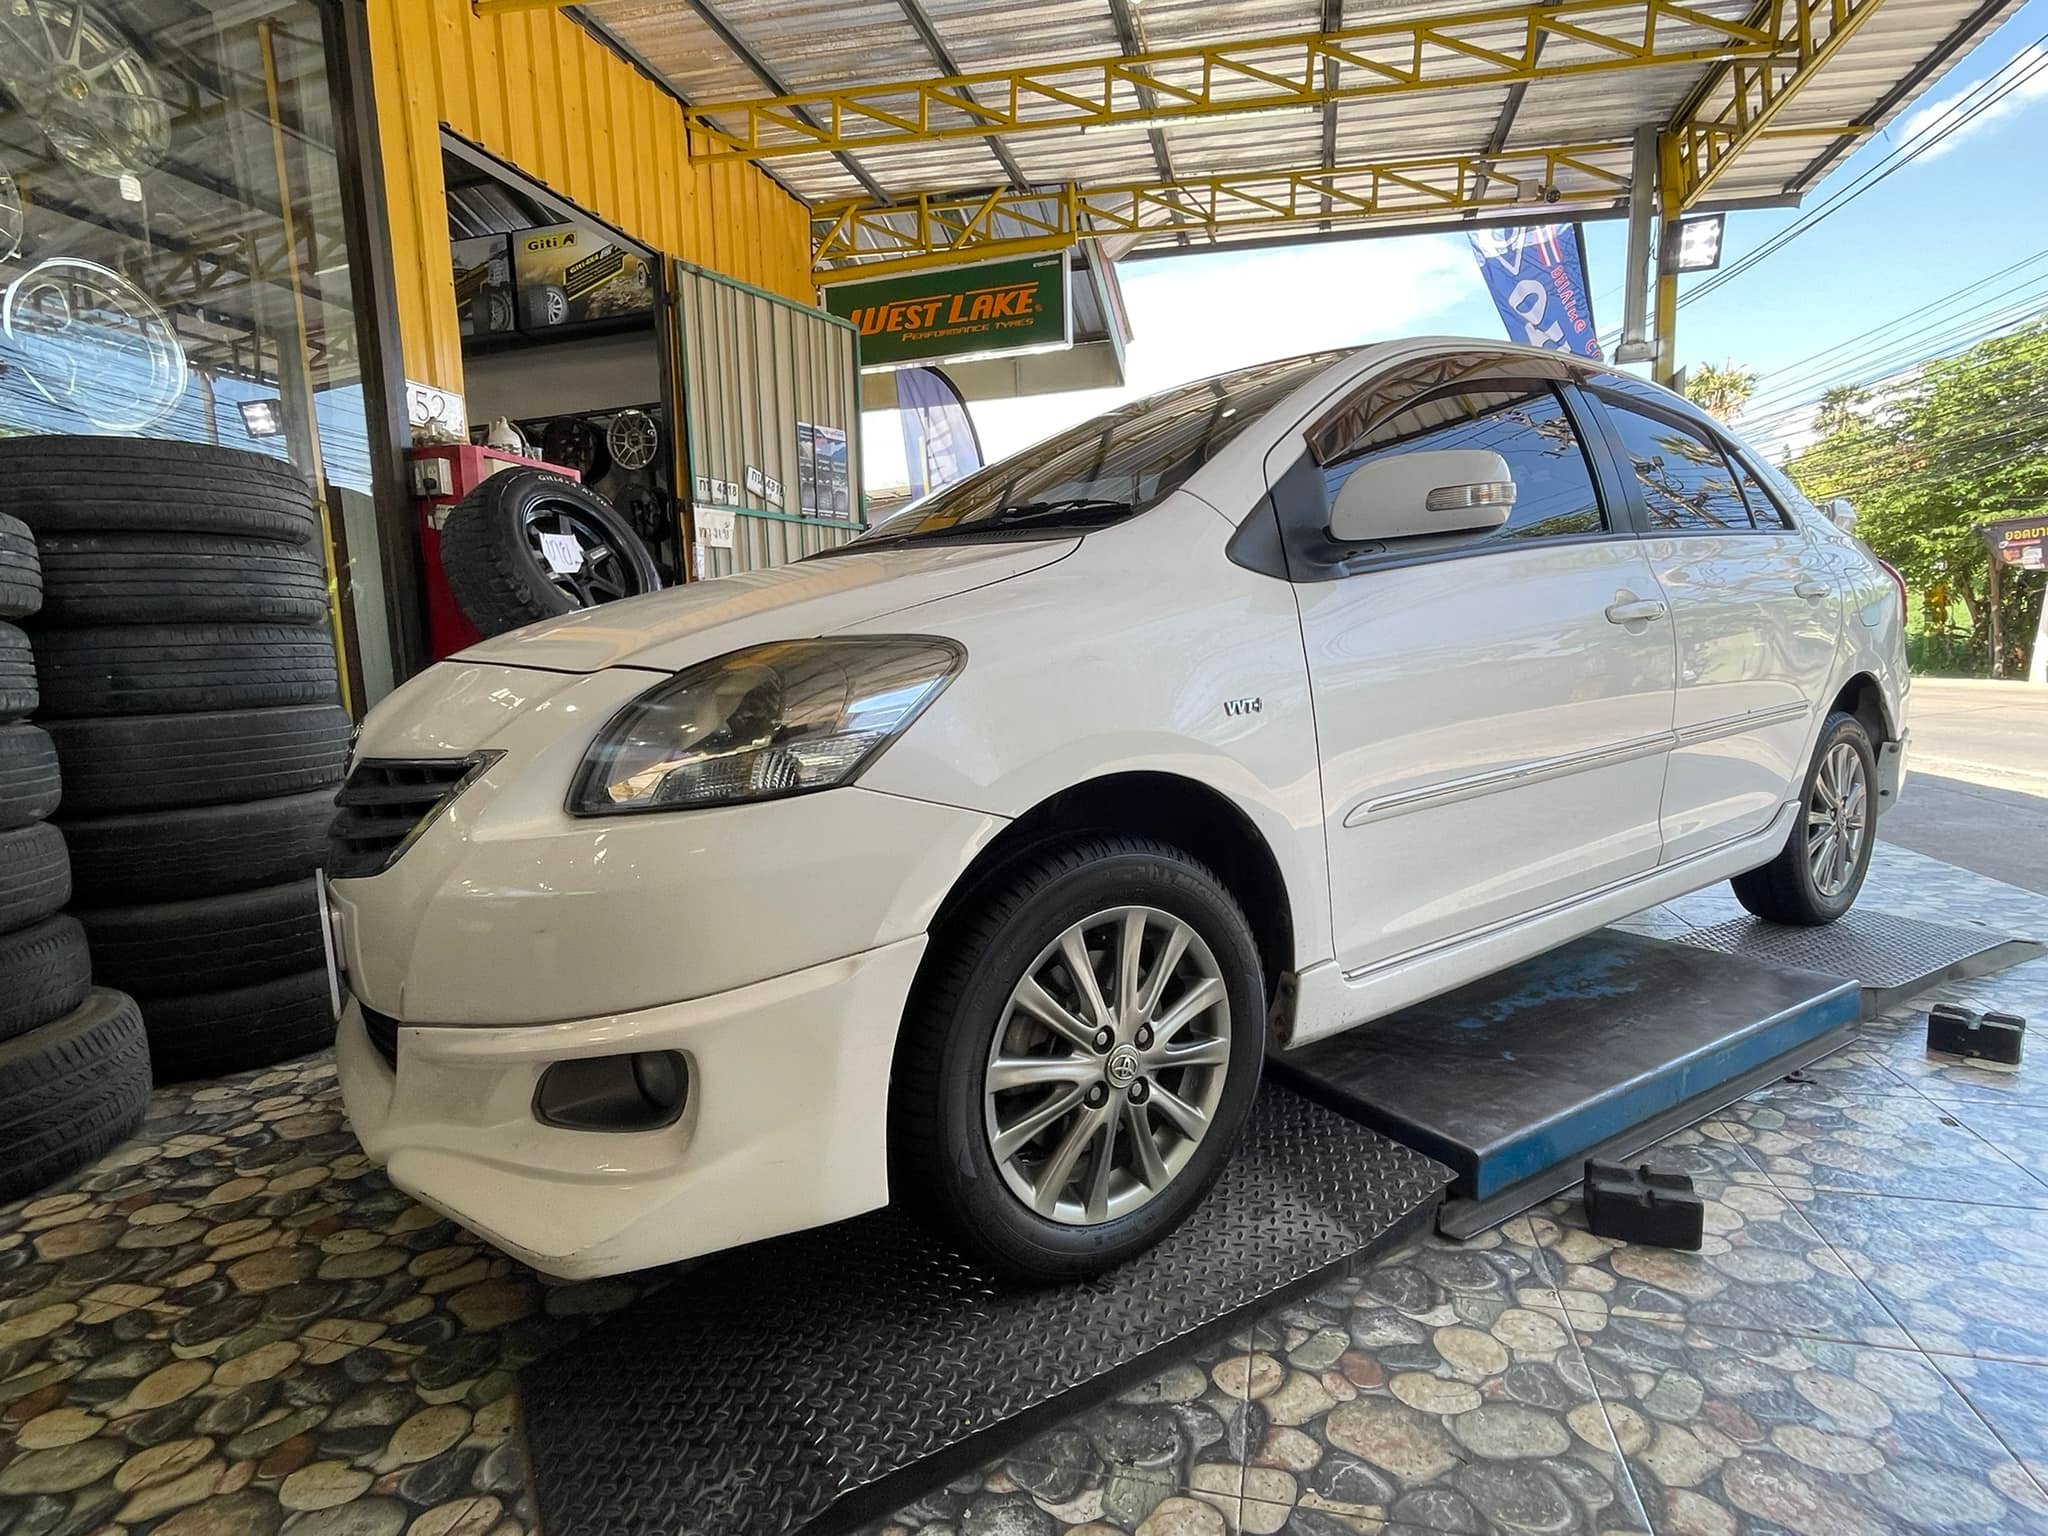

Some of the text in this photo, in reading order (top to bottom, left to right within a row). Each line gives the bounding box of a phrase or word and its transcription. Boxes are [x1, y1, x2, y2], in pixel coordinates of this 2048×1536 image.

[528, 237, 557, 250] Giti
[850, 288, 1038, 336] WEST LAKE
[902, 318, 1035, 342] PERFORMANCE TYRES
